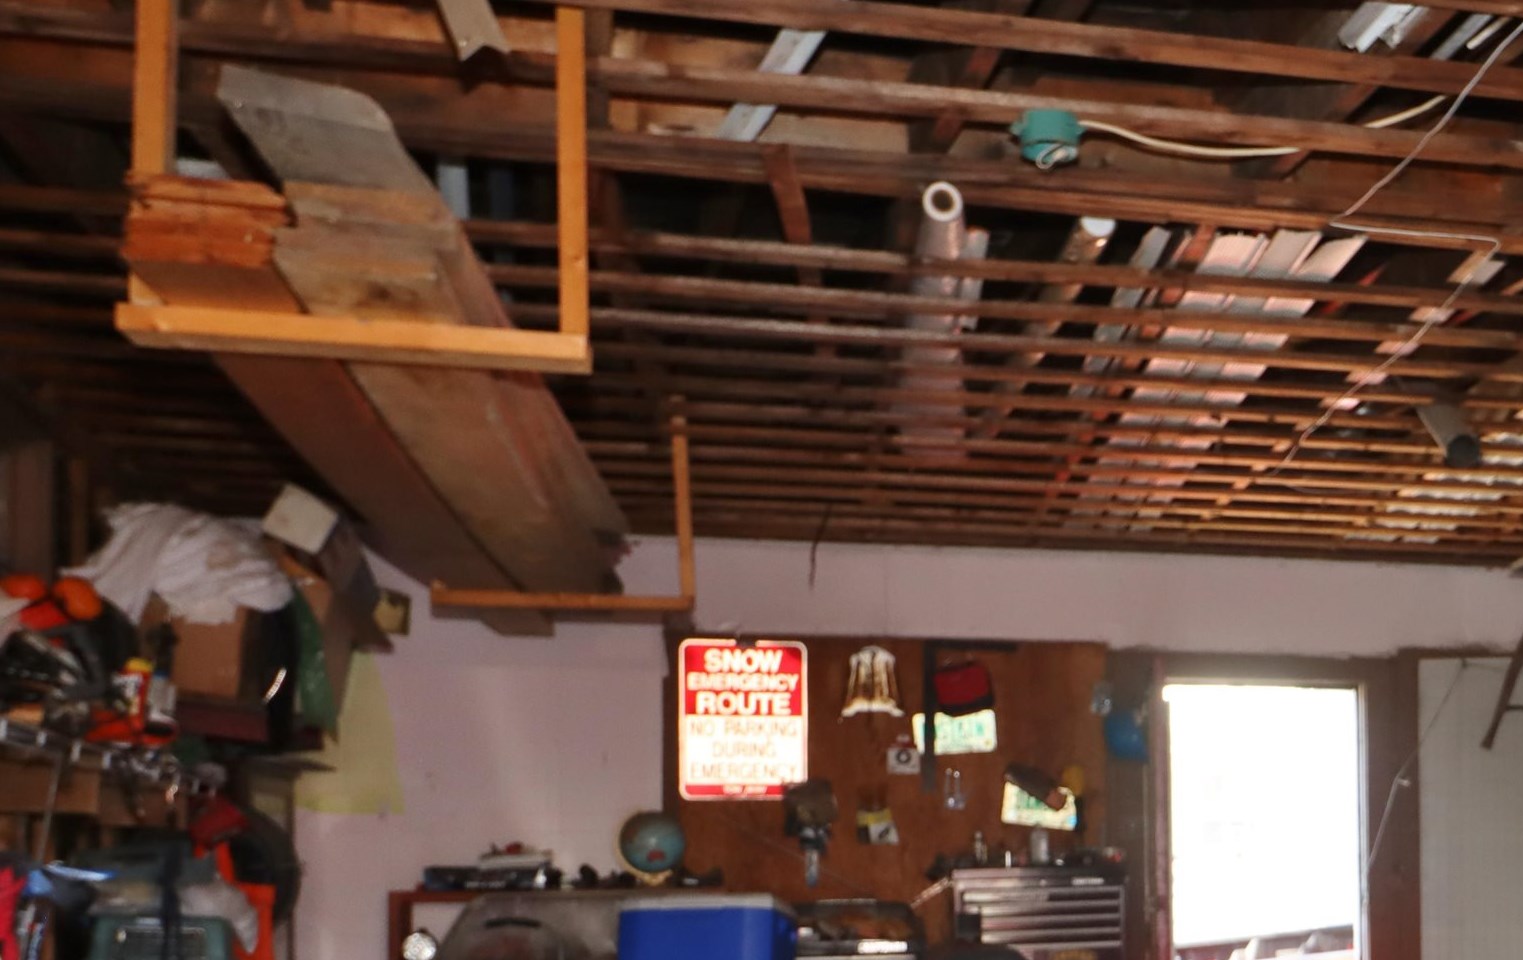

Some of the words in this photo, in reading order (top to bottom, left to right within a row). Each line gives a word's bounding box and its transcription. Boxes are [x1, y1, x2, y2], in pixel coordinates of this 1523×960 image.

[704, 648, 782, 673] SNOW
[687, 672, 799, 691] EMERGENCY
[696, 691, 791, 715] ROUTE
[691, 719, 714, 737] NO
[724, 719, 798, 737] PARKING
[712, 740, 777, 758] DURING
[690, 762, 797, 779] EMERGENCY
